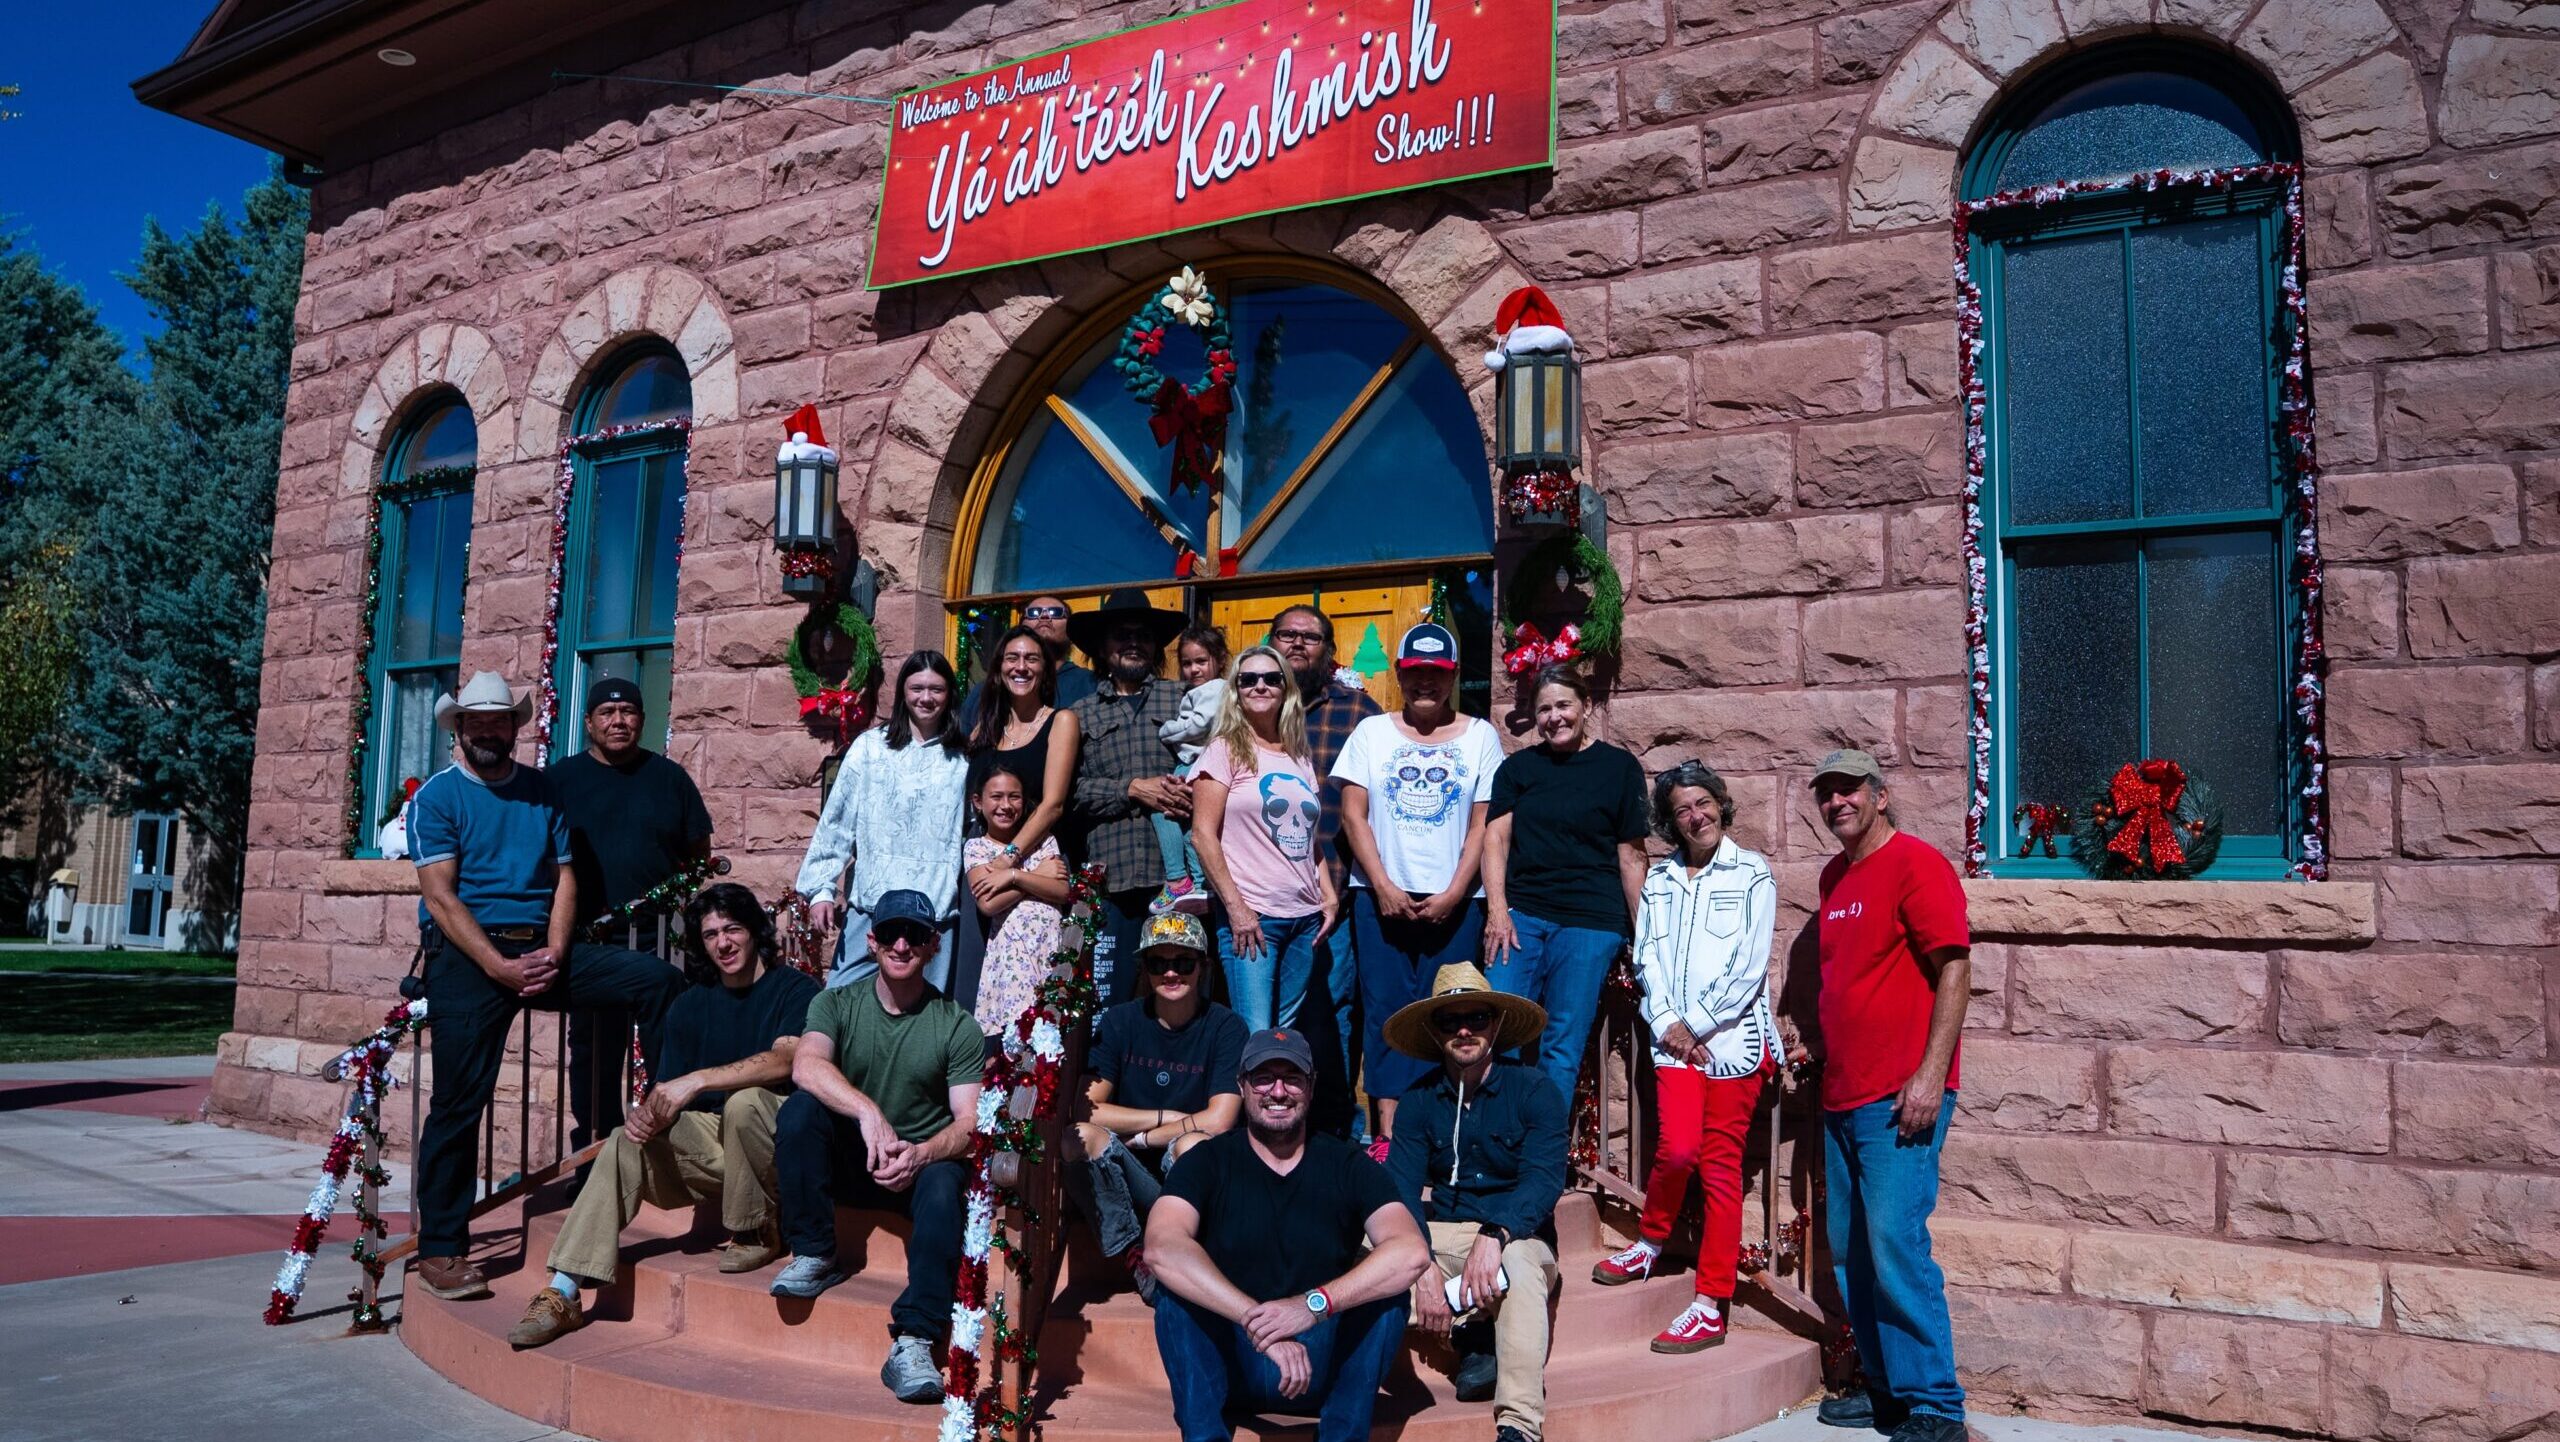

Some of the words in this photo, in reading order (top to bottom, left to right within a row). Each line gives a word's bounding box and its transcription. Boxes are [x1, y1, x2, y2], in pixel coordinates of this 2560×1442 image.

[902, 95, 960, 129] Welcome
[964, 86, 980, 111] to
[984, 75, 1008, 106] the
[1006, 54, 1071, 101] Annual
[1176, 0, 1450, 199] Keshmish
[1374, 93, 1495, 163] Show!!!
